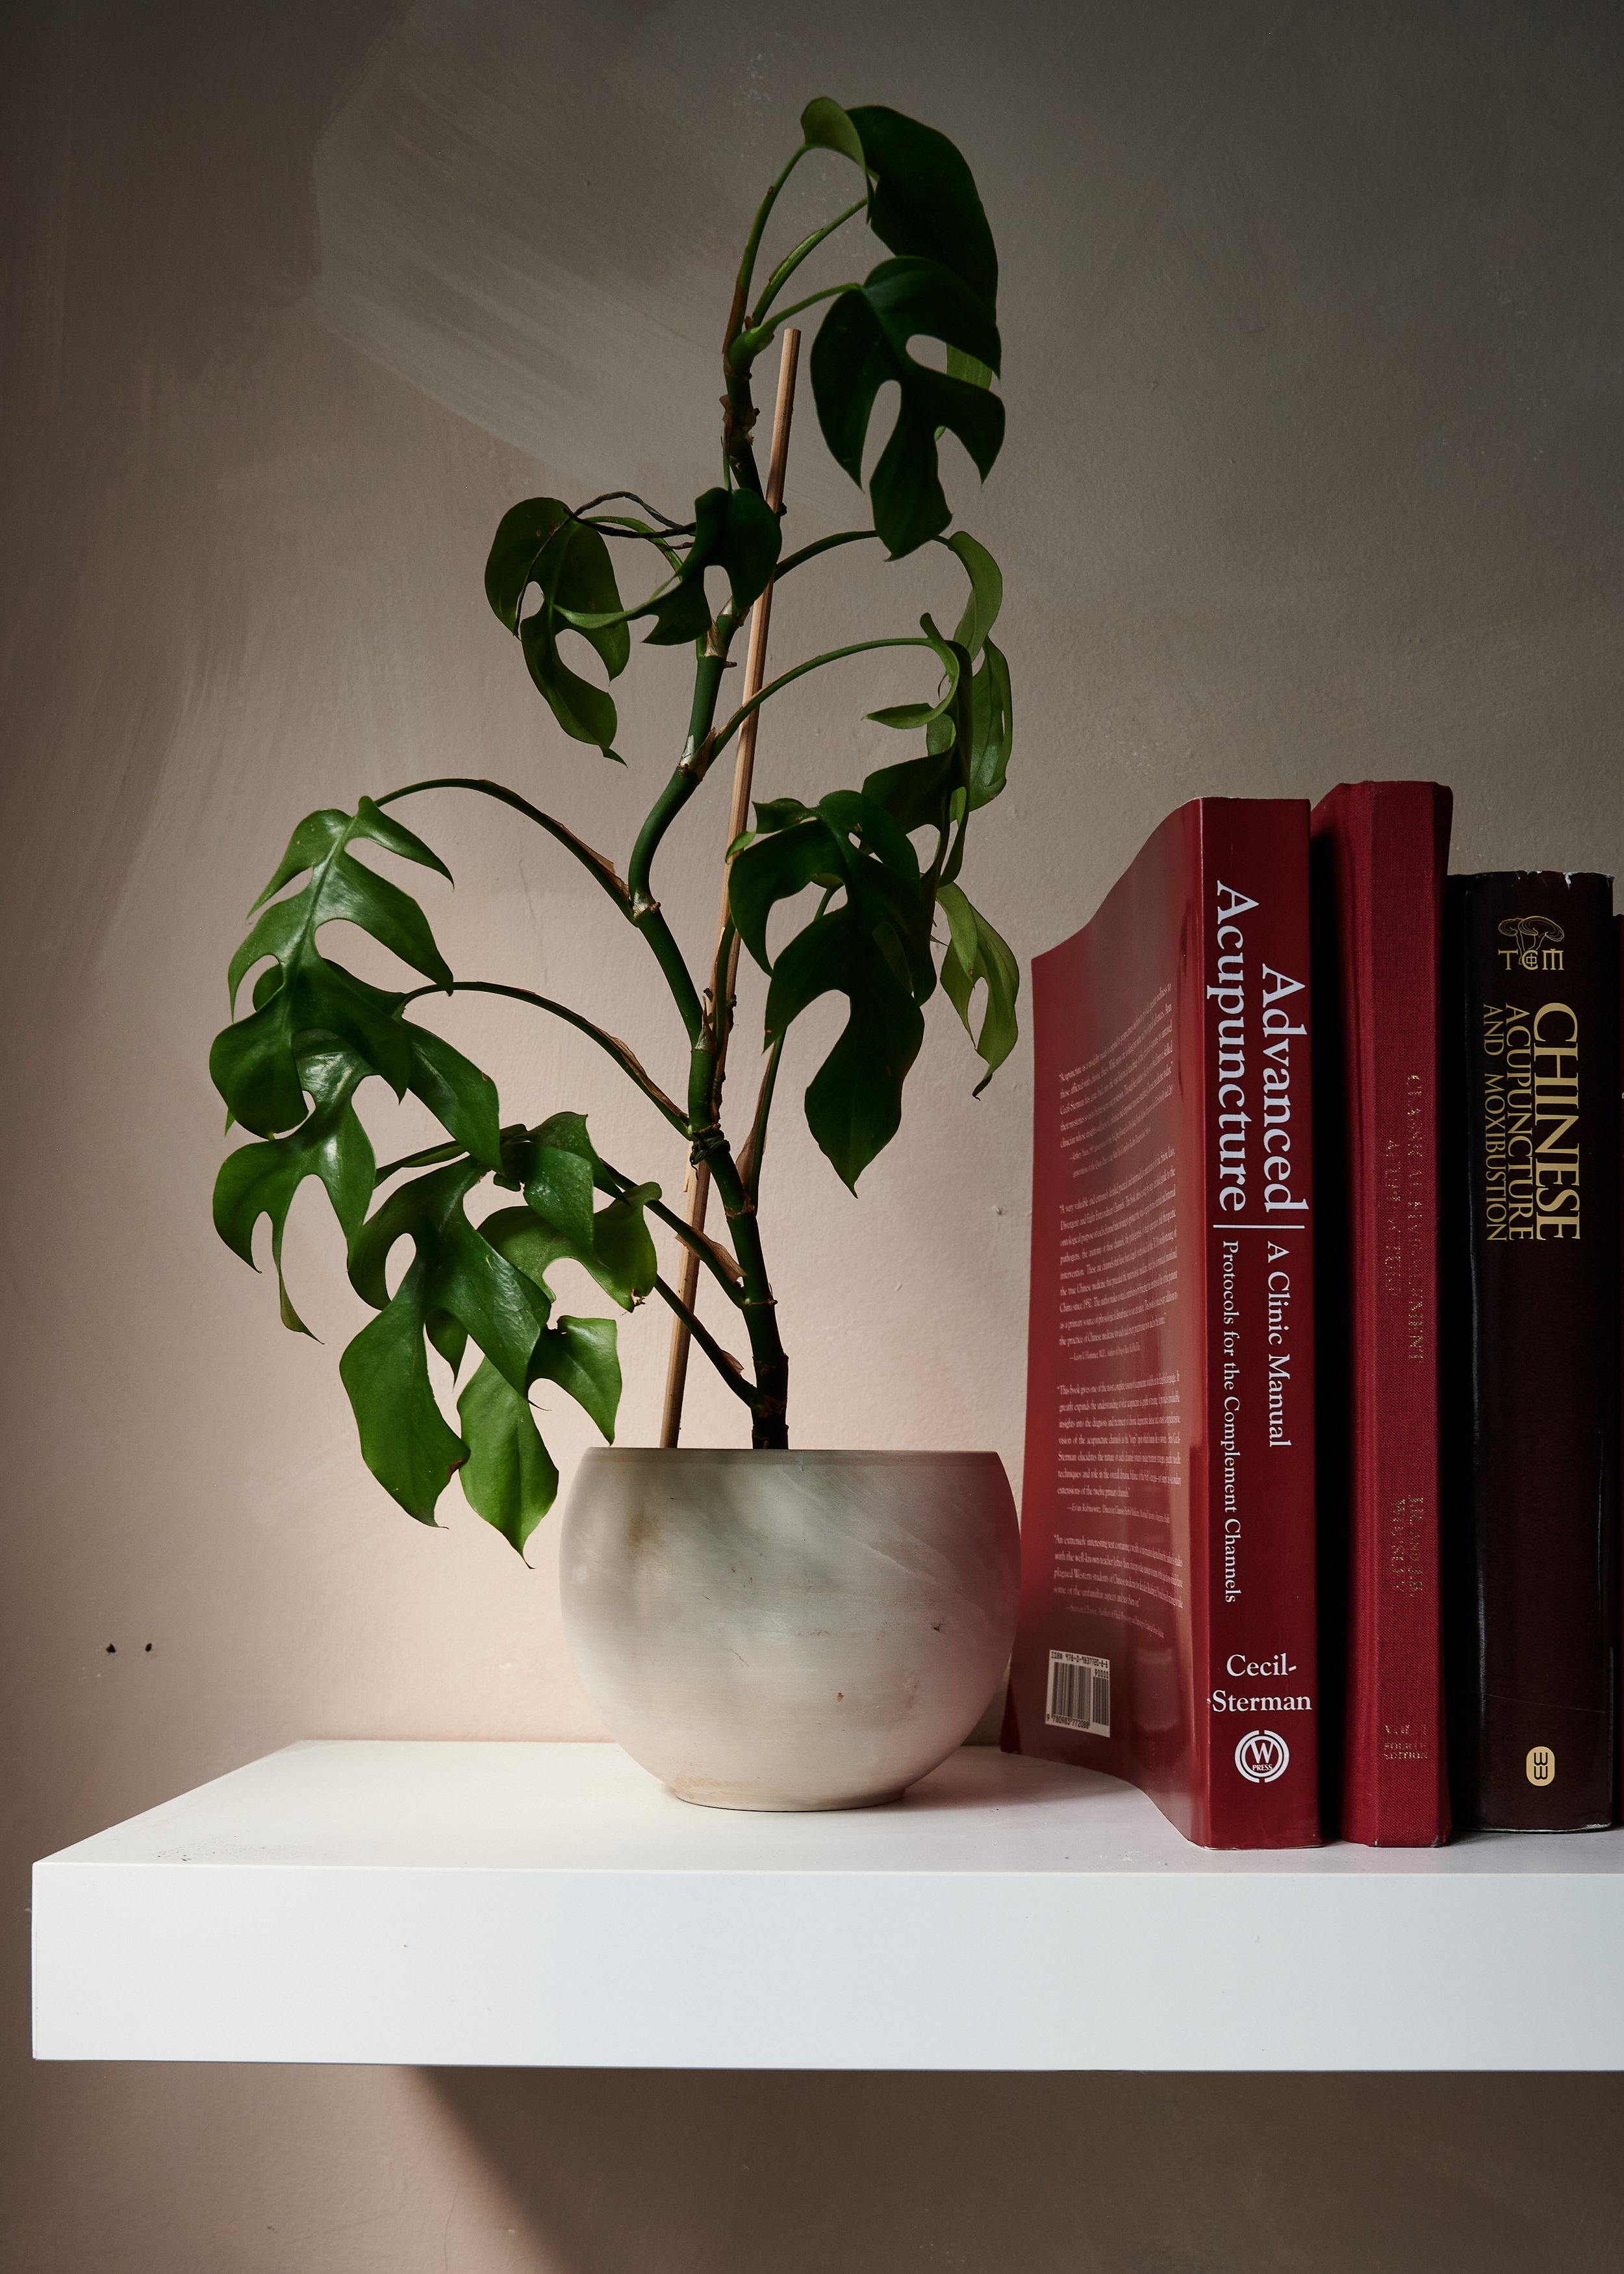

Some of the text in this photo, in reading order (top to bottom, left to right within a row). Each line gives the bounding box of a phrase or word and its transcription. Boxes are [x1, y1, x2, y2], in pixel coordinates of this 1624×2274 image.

[1207, 880, 1259, 1211] Acupuncture
[1498, 948, 1564, 970] TCM
[1263, 963, 1309, 1212] Advanced
[1484, 1005, 1508, 1240] AND MOXIBUSTION
[1505, 1003, 1534, 1241] ACUPUNCTURE
[1532, 1003, 1580, 1240] CHINESE
[1076, 1283, 1091, 1293] Chinese
[1268, 1241, 1291, 1447] A Clinic Manual
[1221, 1241, 1241, 1602] Protocols for the Complement Channels
[1213, 1690, 1312, 1712] Sterman
[1227, 1653, 1296, 1676] Cecil-
